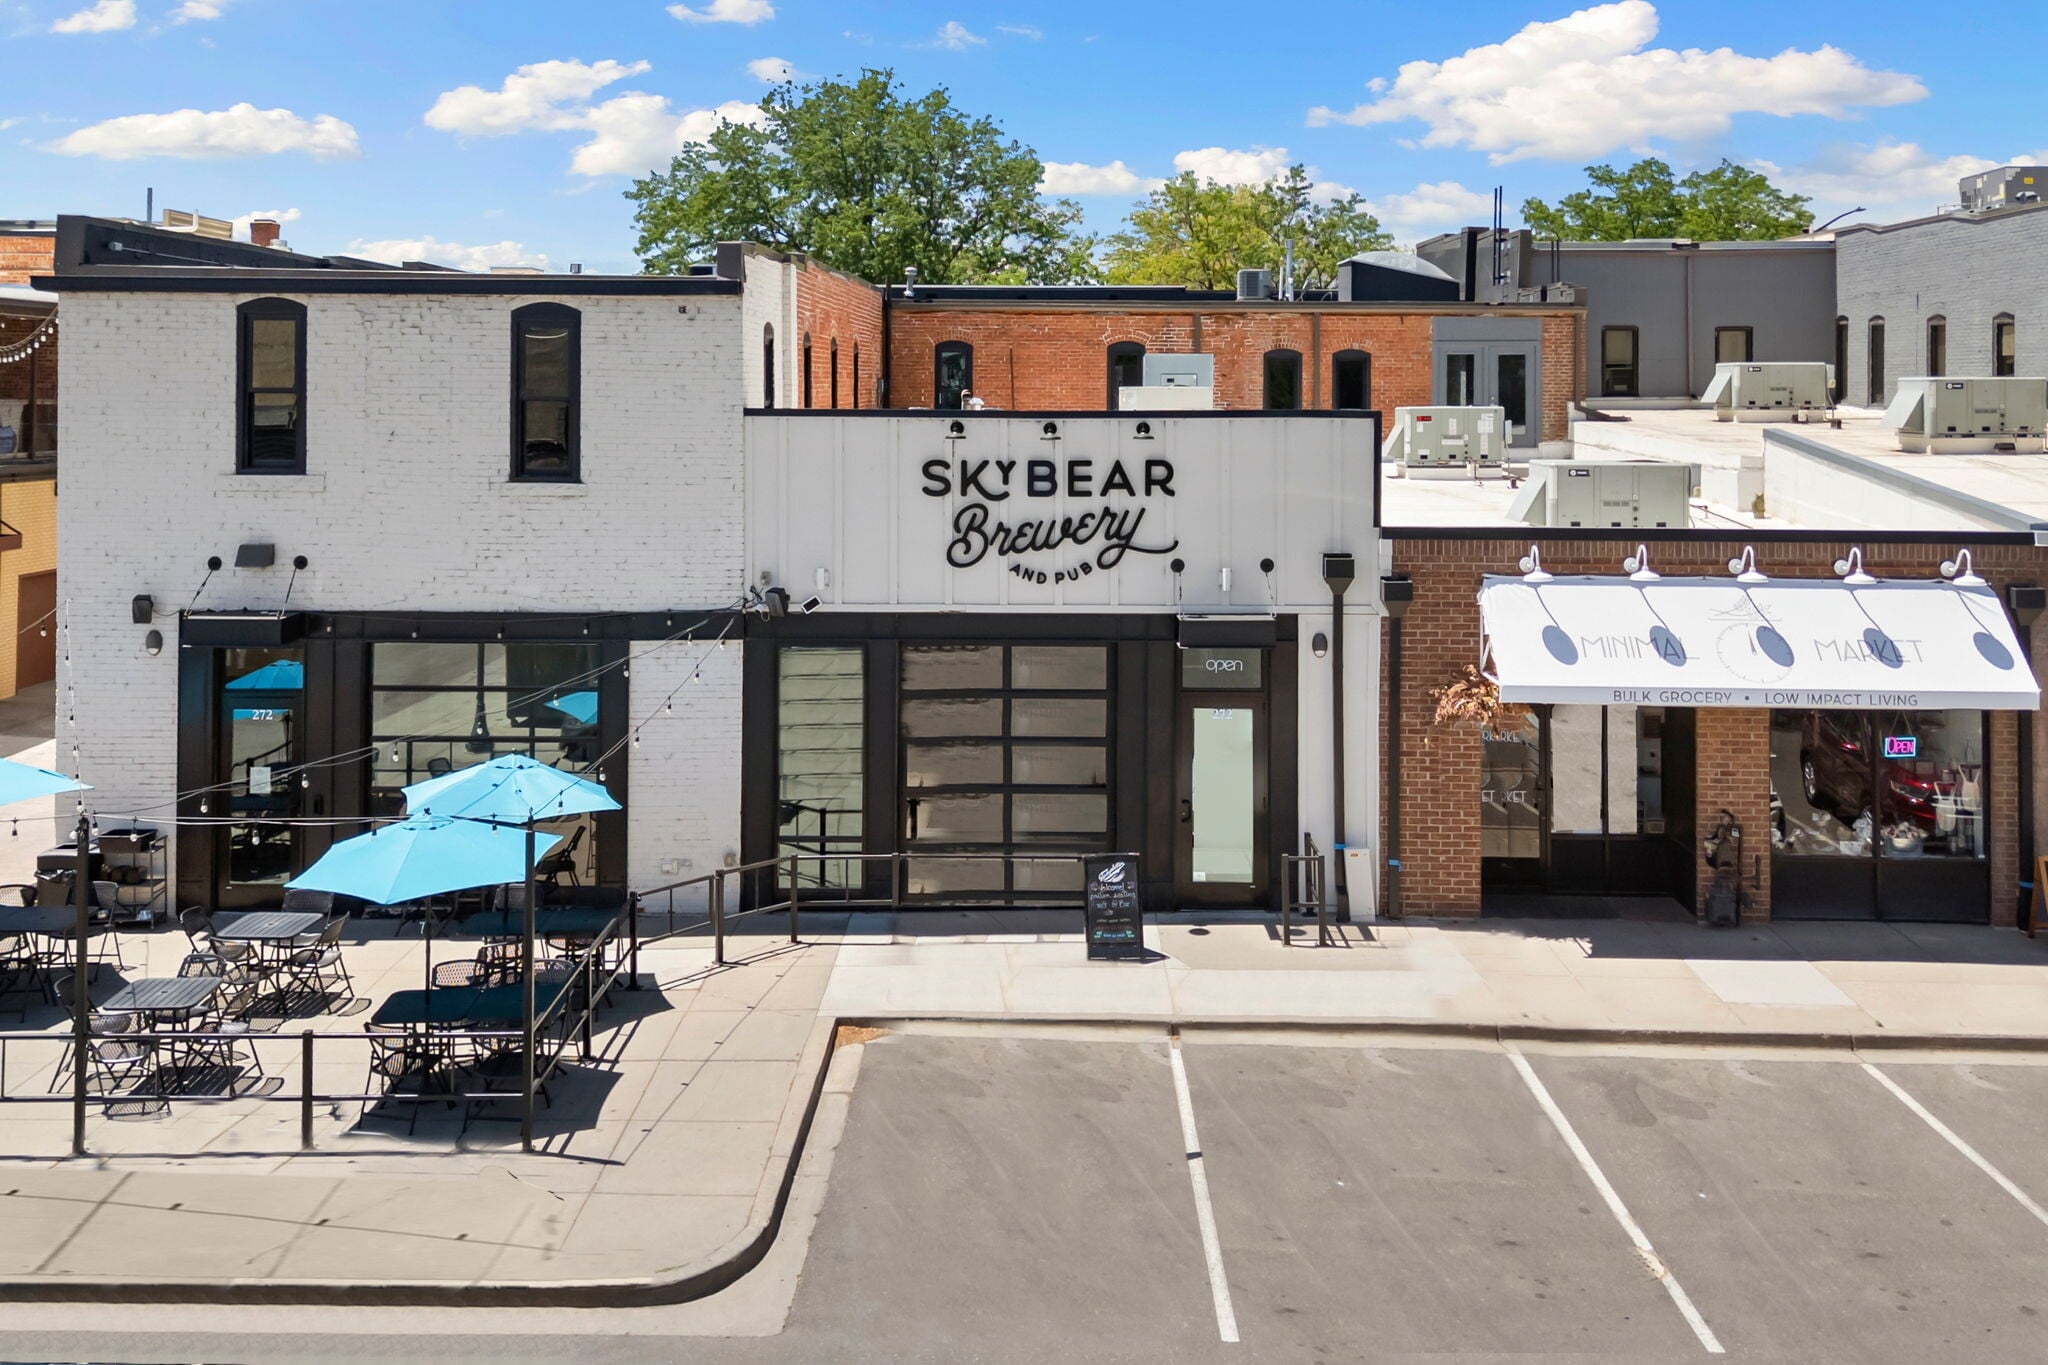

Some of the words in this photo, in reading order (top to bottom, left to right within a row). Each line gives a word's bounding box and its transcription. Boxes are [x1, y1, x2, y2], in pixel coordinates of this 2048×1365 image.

[921, 459, 1176, 501] SKYBEAR
[946, 502, 1179, 569] Brewery
[1009, 563, 1047, 584] AND
[1055, 561, 1093, 584] PUB
[1580, 635, 1701, 660] MINIMAL
[1813, 638, 1923, 663] MARKET
[1205, 659, 1243, 673] open
[1613, 690, 1652, 703] BULK
[1659, 691, 1732, 704] GROCERY
[1765, 692, 1799, 705] LOW
[1806, 693, 1862, 706] IMPACT
[1869, 694, 1918, 706] LIVING
[252, 709, 273, 720] 272
[1212, 708, 1233, 720] 272
